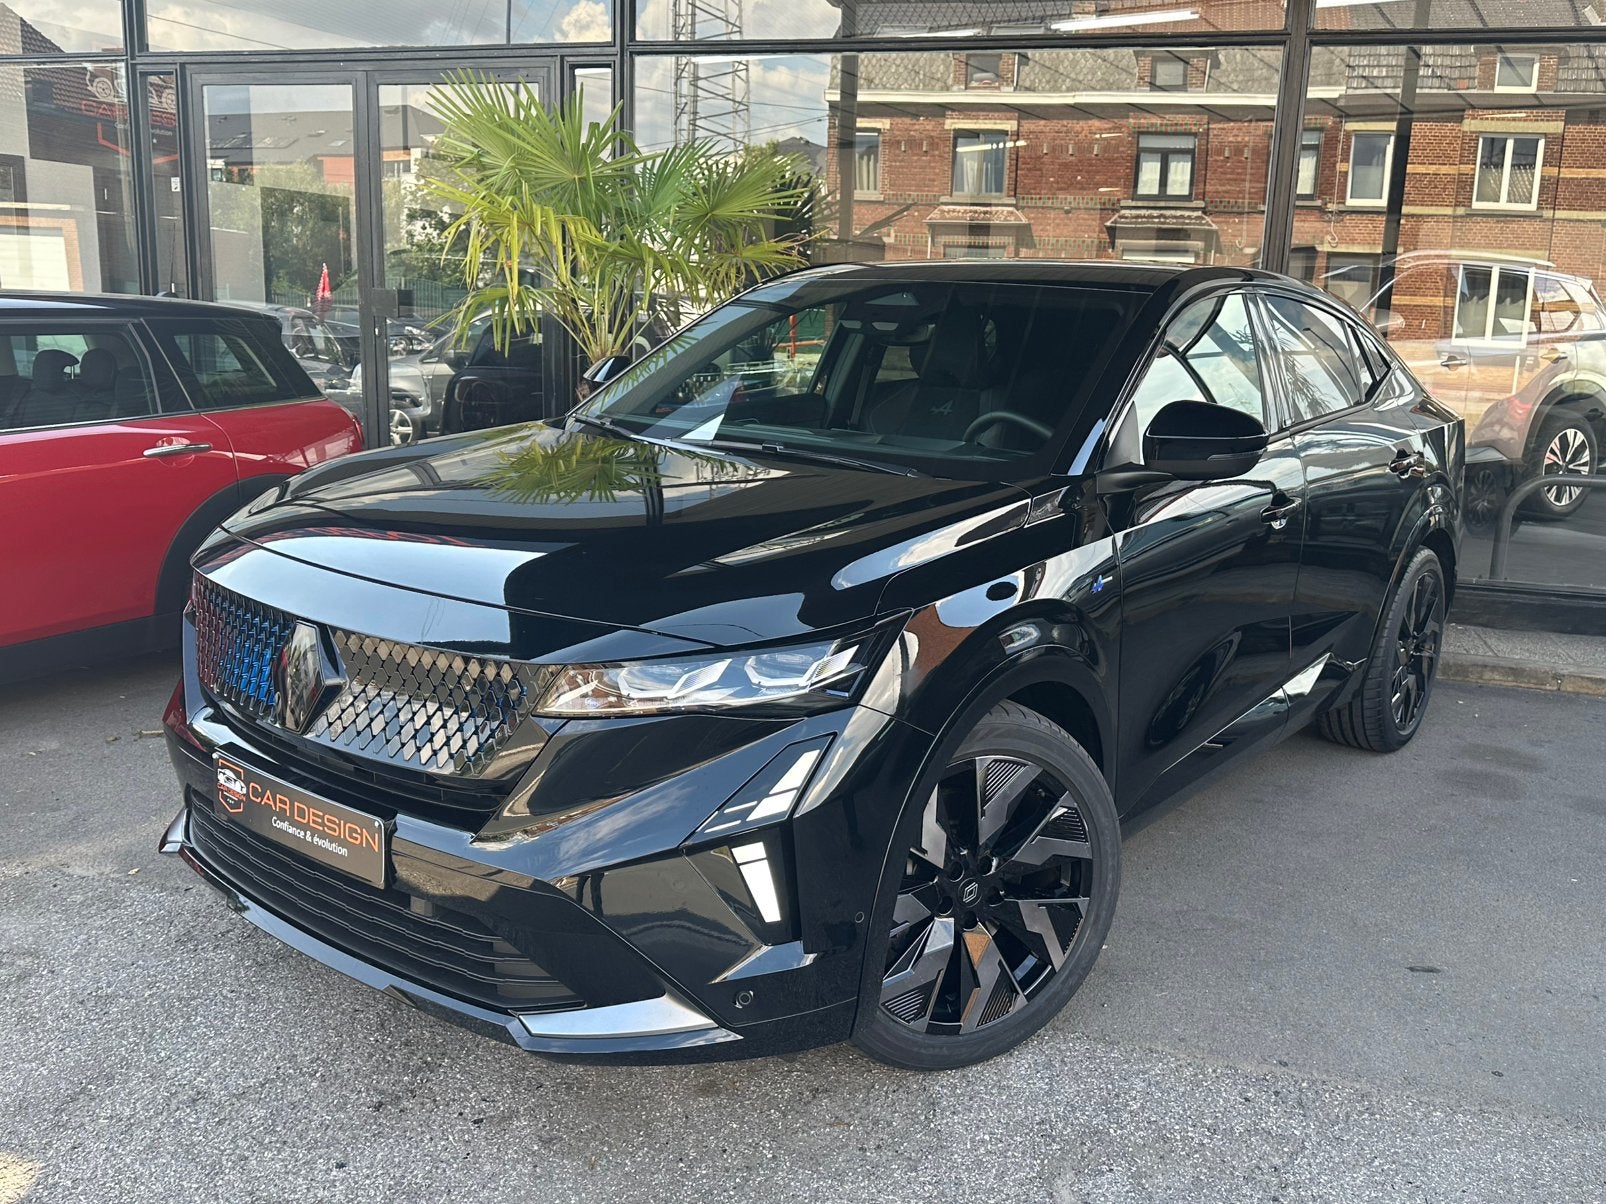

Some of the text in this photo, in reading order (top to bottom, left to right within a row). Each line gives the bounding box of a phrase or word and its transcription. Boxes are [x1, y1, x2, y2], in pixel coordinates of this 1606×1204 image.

[249, 782, 379, 852] CAR DESIGN
[271, 816, 348, 857] Confiance & évolution
